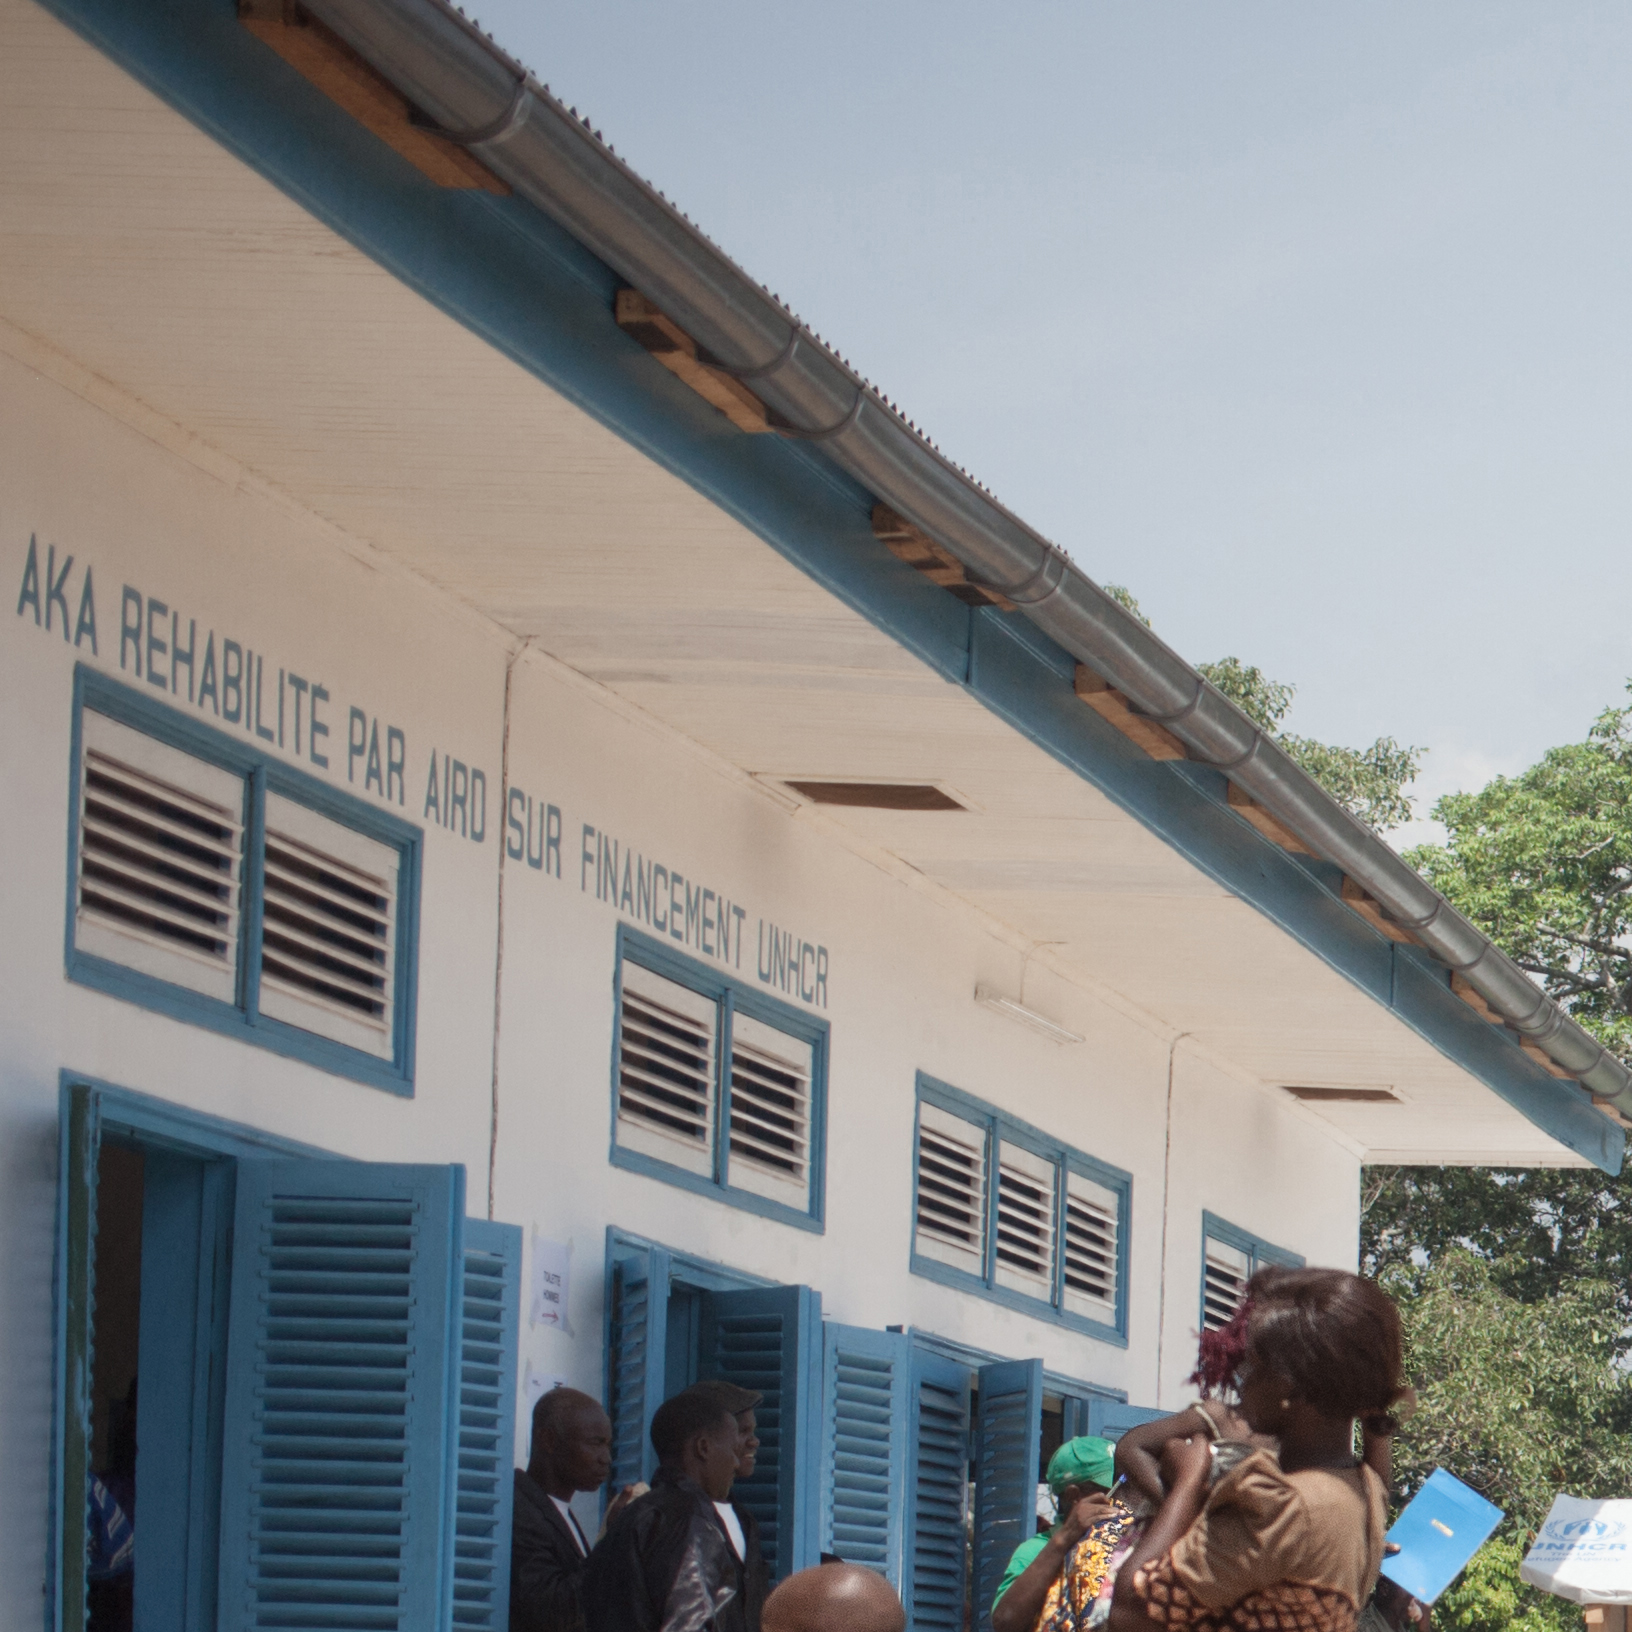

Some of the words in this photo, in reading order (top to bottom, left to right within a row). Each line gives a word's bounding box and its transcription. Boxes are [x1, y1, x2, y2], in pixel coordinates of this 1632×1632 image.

[17, 532, 98, 657] AKA
[348, 705, 405, 807] PAR
[424, 748, 486, 843] AIRD
[507, 787, 562, 880] SUR
[581, 823, 746, 970] FINANCEMENT
[757, 918, 829, 1009] UNHCR
